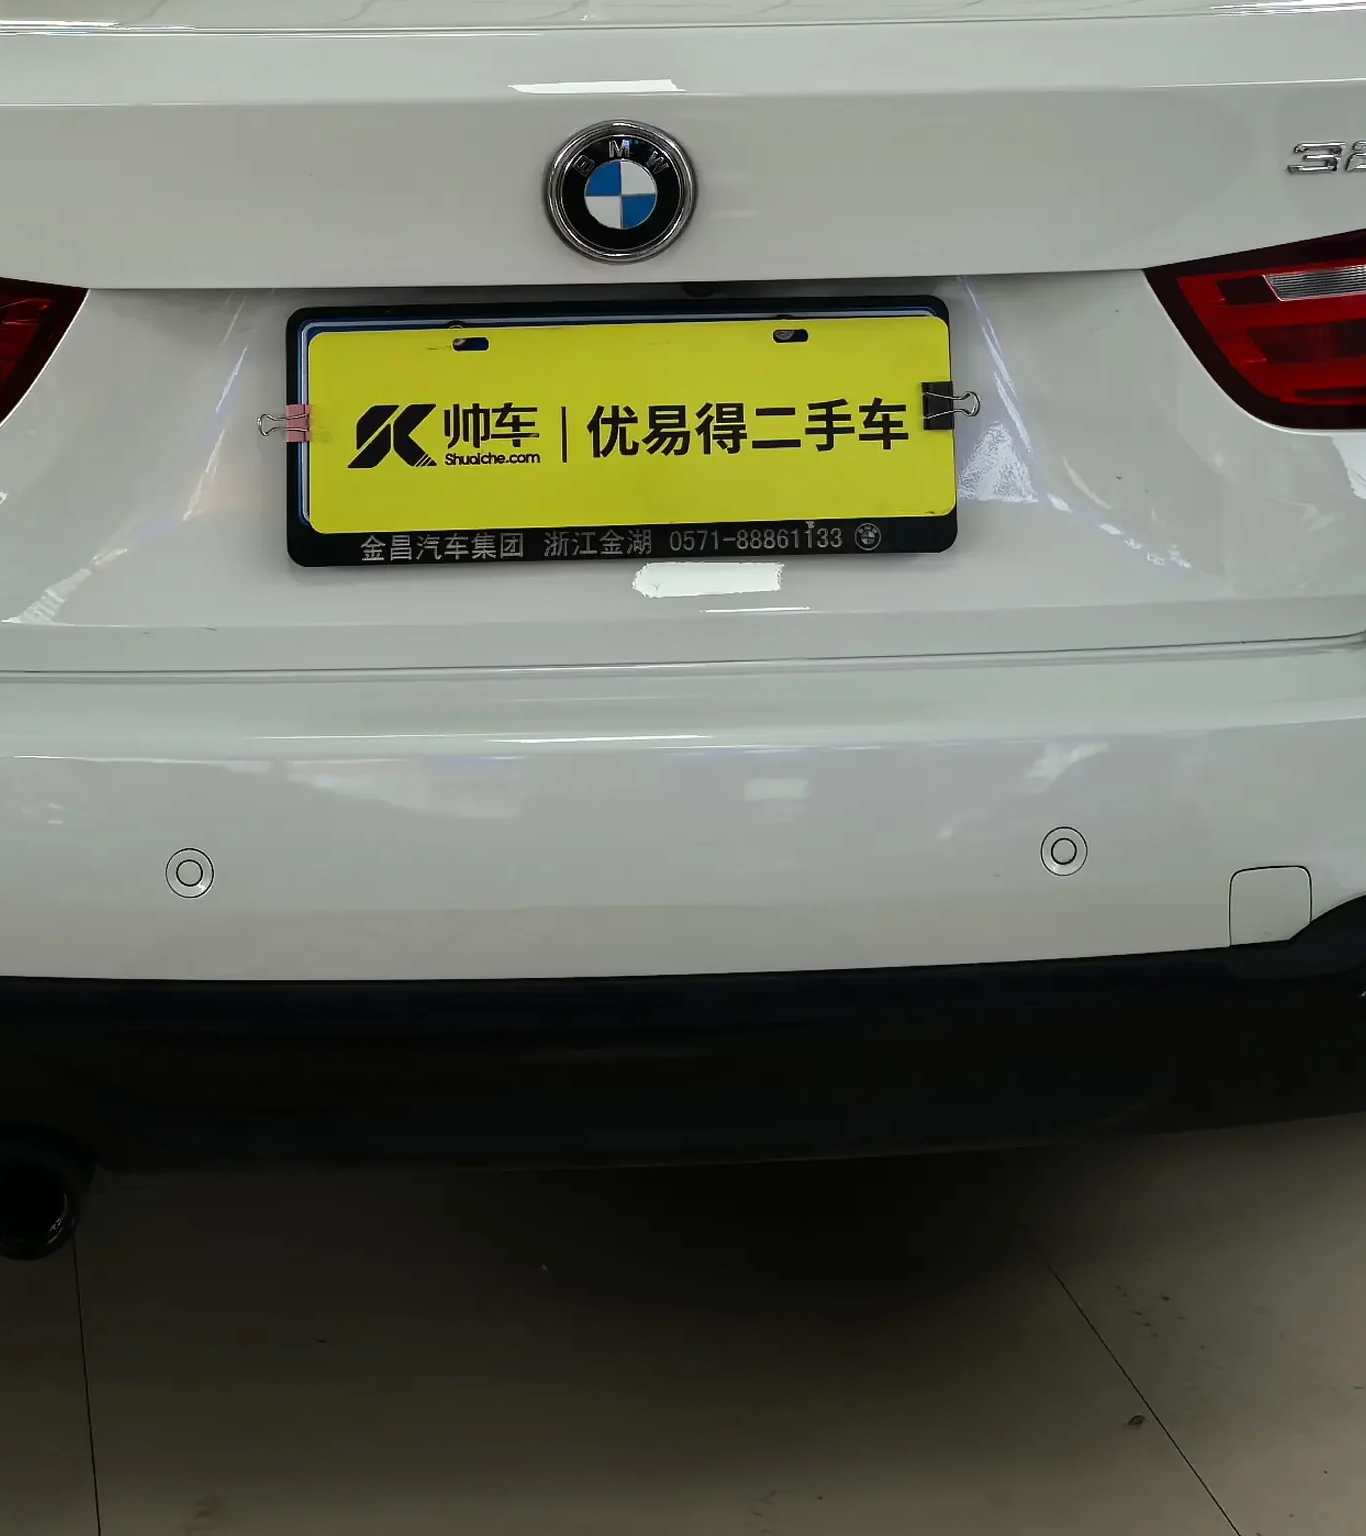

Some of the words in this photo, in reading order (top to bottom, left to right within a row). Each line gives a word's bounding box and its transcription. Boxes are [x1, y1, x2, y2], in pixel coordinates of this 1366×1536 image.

[572, 139, 671, 178] BMW
[443, 402, 540, 449] 帅车
[586, 397, 909, 458] 优易得二手车
[444, 452, 541, 466] Shuaiche.com
[360, 532, 525, 562] 金昌汽车集团
[543, 528, 652, 556] 浙江金湖
[669, 527, 843, 552] 0571-88861133
